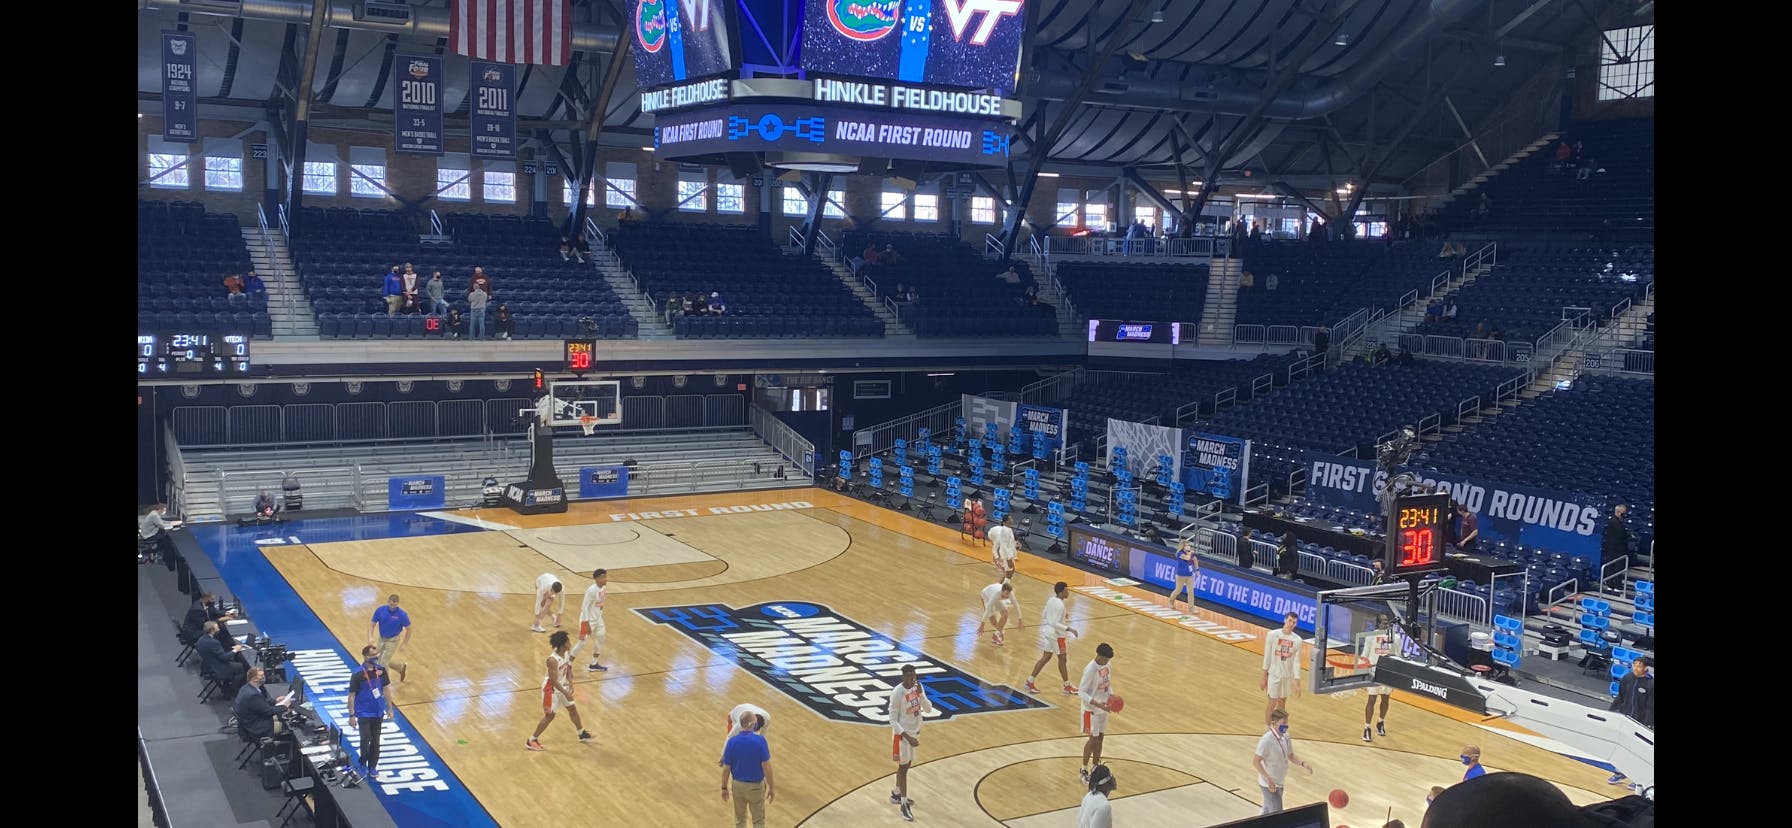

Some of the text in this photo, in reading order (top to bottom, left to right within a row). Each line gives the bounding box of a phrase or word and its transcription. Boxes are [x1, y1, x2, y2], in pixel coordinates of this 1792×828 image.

[909, 16, 926, 32] VS
[167, 63, 192, 79] 1924
[402, 80, 435, 105] 2010
[479, 87, 507, 110] 2011
[641, 78, 723, 113] HINKLE FIELDHOUSE
[814, 78, 1001, 116] HINKLE FIELDHOUSE
[662, 119, 723, 144] NCAA FIRST ROUND
[836, 121, 972, 149] NCAA FIRST ROUND
[173, 335, 206, 346] 23:41
[236, 344, 245, 355] 0
[144, 344, 152, 356] 0
[186, 350, 193, 359] 0
[138, 363, 146, 372] 0
[159, 363, 166, 371] 4
[214, 363, 221, 371] 4
[240, 362, 246, 371] 0
[571, 353, 589, 368] 30
[1586, 359, 1600, 368] 206
[1028, 410, 1049, 423] MARCH
[1030, 421, 1058, 435] MADNESS
[1197, 440, 1226, 455] MARCH
[1199, 452, 1238, 470] MADNESS
[507, 485, 524, 503] NCAA
[1311, 461, 1370, 493] FIRST
[1488, 489, 1599, 536] ROUNDS
[609, 501, 815, 522] FIRST ROUND
[1400, 508, 1438, 529] 23:41
[1085, 541, 1114, 562] DANCE
[1403, 530, 1433, 565] 30
[1155, 562, 1317, 624] WELME TO THE BIG DANCE
[766, 605, 803, 618] NCAA
[772, 616, 948, 677] MARCH
[720, 630, 943, 722] MADNESS
[1411, 679, 1448, 699] SPALDING
